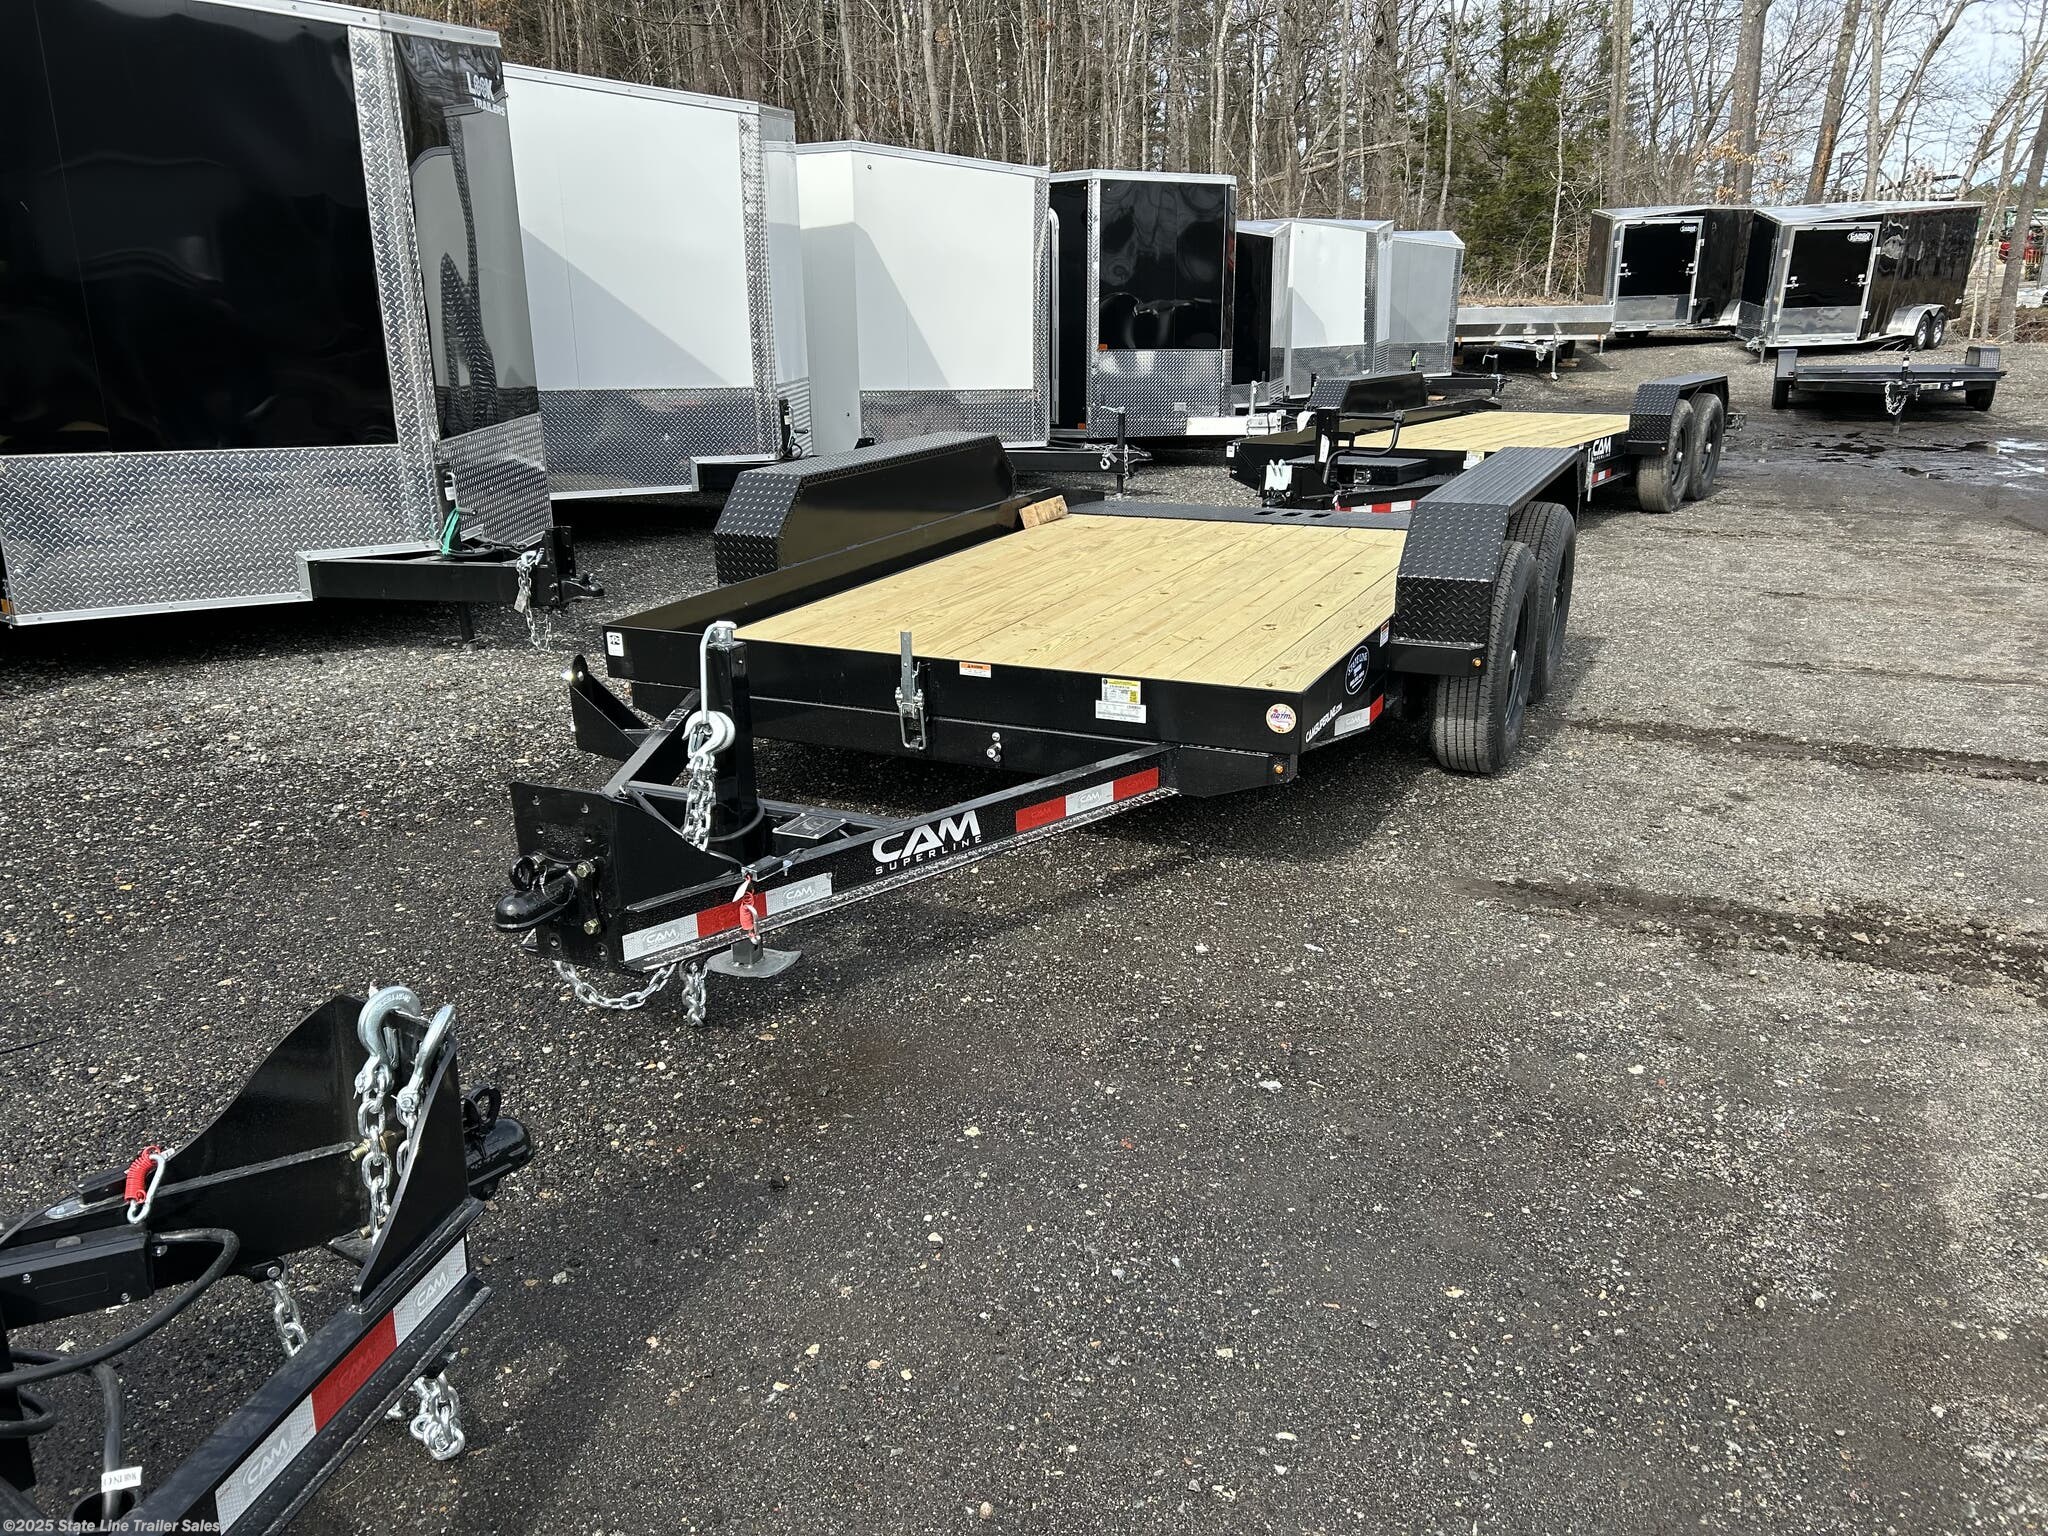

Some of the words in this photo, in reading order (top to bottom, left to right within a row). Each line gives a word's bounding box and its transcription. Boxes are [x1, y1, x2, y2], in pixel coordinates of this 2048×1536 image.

[472, 97, 505, 116] TRAILERS
[1592, 437, 1611, 456] CAM
[872, 810, 981, 863] CAM
[874, 835, 982, 876] SUPERLINE
[786, 885, 813, 899] CAM
[646, 927, 678, 944] CAM
[416, 1271, 447, 1307] CAM
[246, 1437, 289, 1486] CAM
